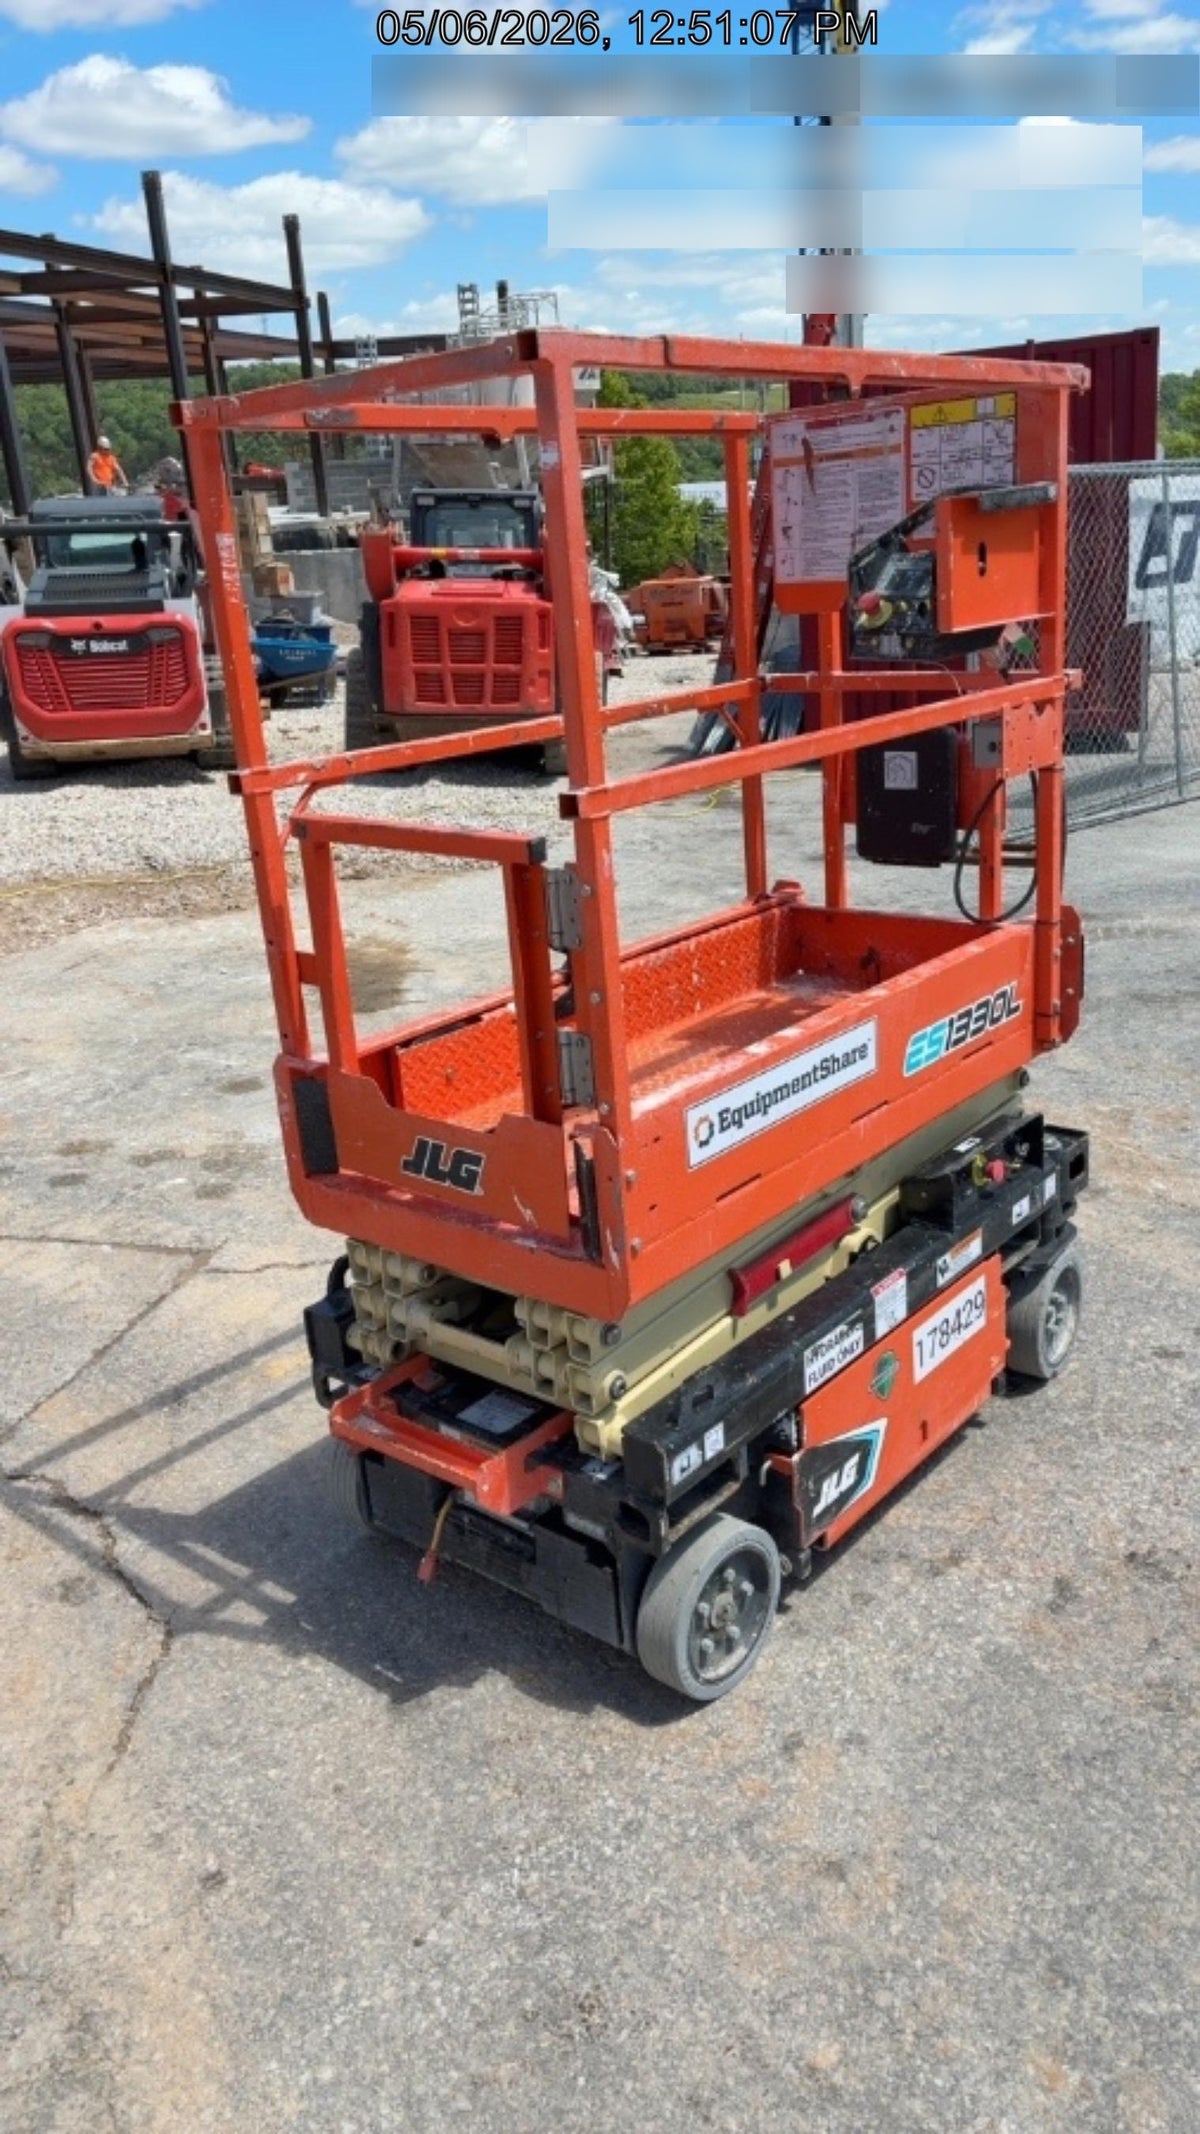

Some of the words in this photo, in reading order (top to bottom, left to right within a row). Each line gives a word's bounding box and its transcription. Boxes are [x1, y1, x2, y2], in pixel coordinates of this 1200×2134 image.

[904, 981, 1022, 1077] ES1330L
[718, 1041, 870, 1134] EquipmentShare
[401, 1135, 485, 1196] JLG
[808, 1357, 836, 1388] FLUID
[837, 1335, 862, 1364] ONLY
[915, 1289, 986, 1369] 178429
[812, 1451, 860, 1519] JLG
